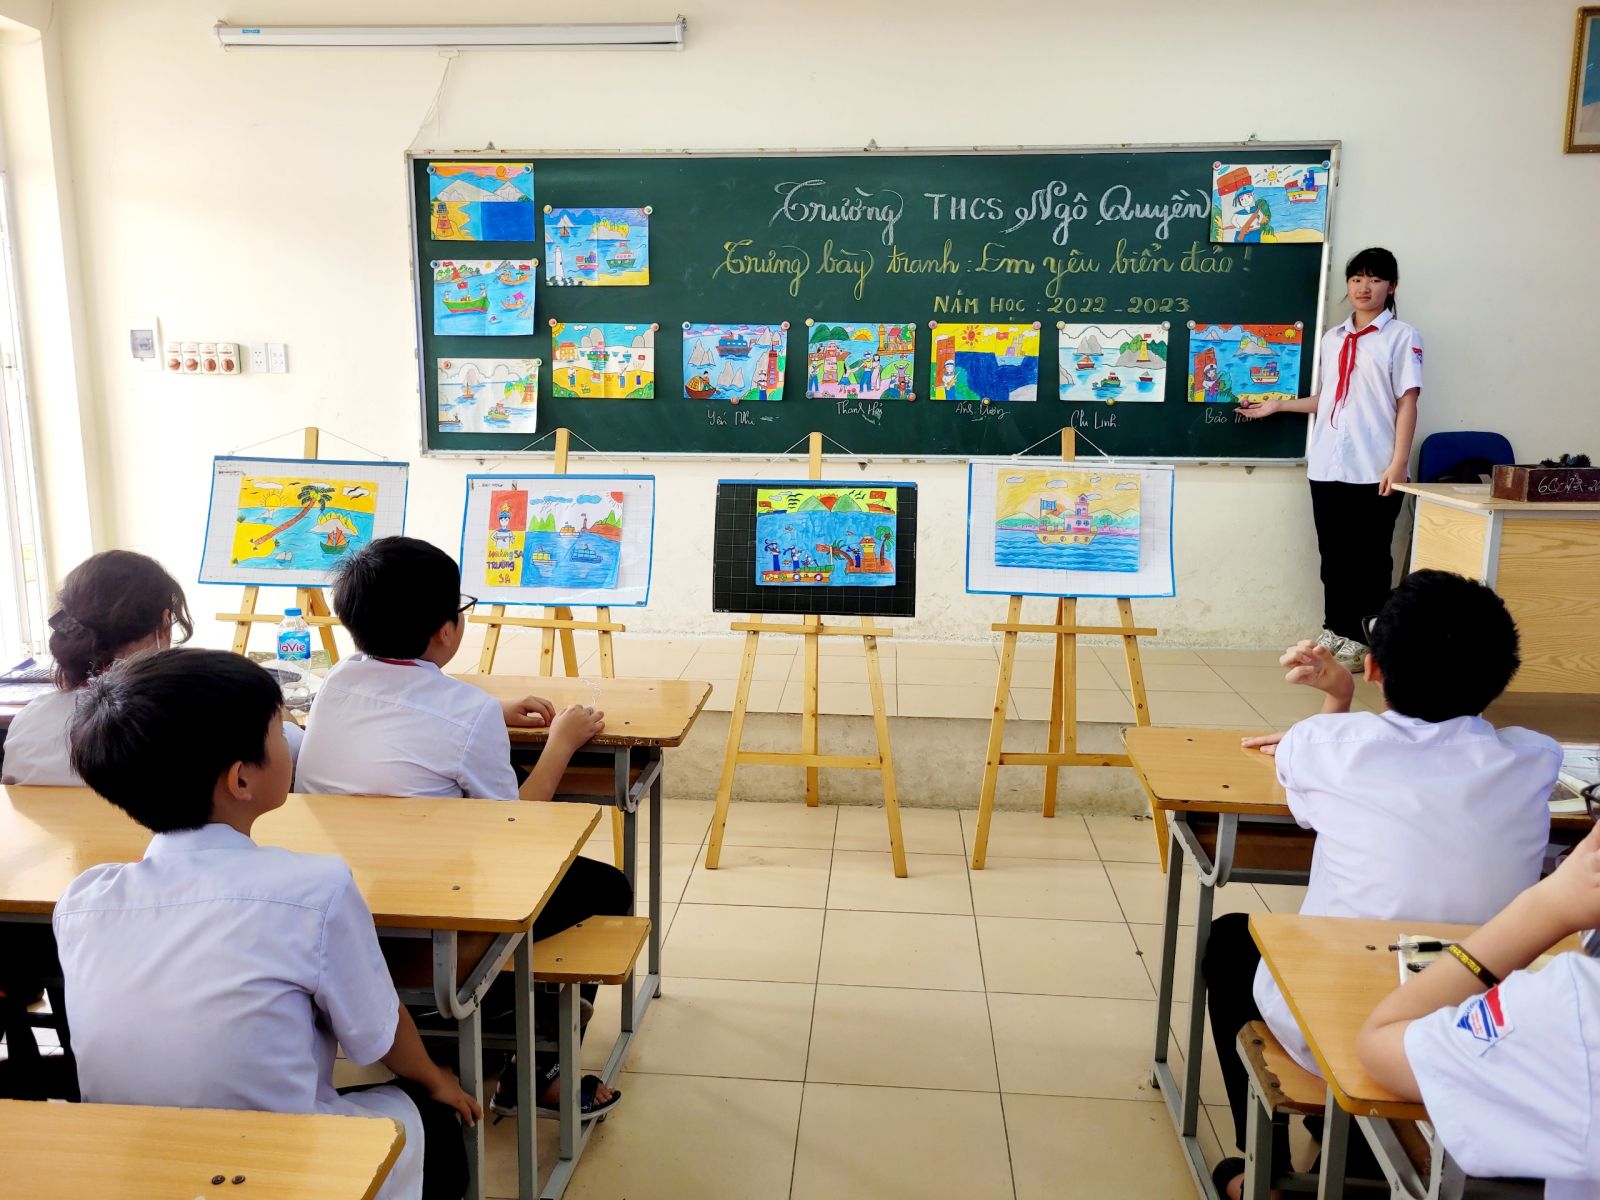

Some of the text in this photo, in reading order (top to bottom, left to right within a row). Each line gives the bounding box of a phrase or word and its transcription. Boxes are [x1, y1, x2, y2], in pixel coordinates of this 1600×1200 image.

[769, 178, 1212, 247] Trường THCS Ngô Quyền
[712, 239, 811, 298] Trưng
[816, 238, 875, 301] bày
[975, 241, 1036, 275] Em
[1042, 249, 1100, 299] yêu
[1107, 238, 1174, 274] biển
[1047, 296, 1106, 314] 2022
[1127, 296, 1191, 314] 2023
[835, 399, 865, 415] Thanh
[1205, 407, 1228, 424] Bảo
